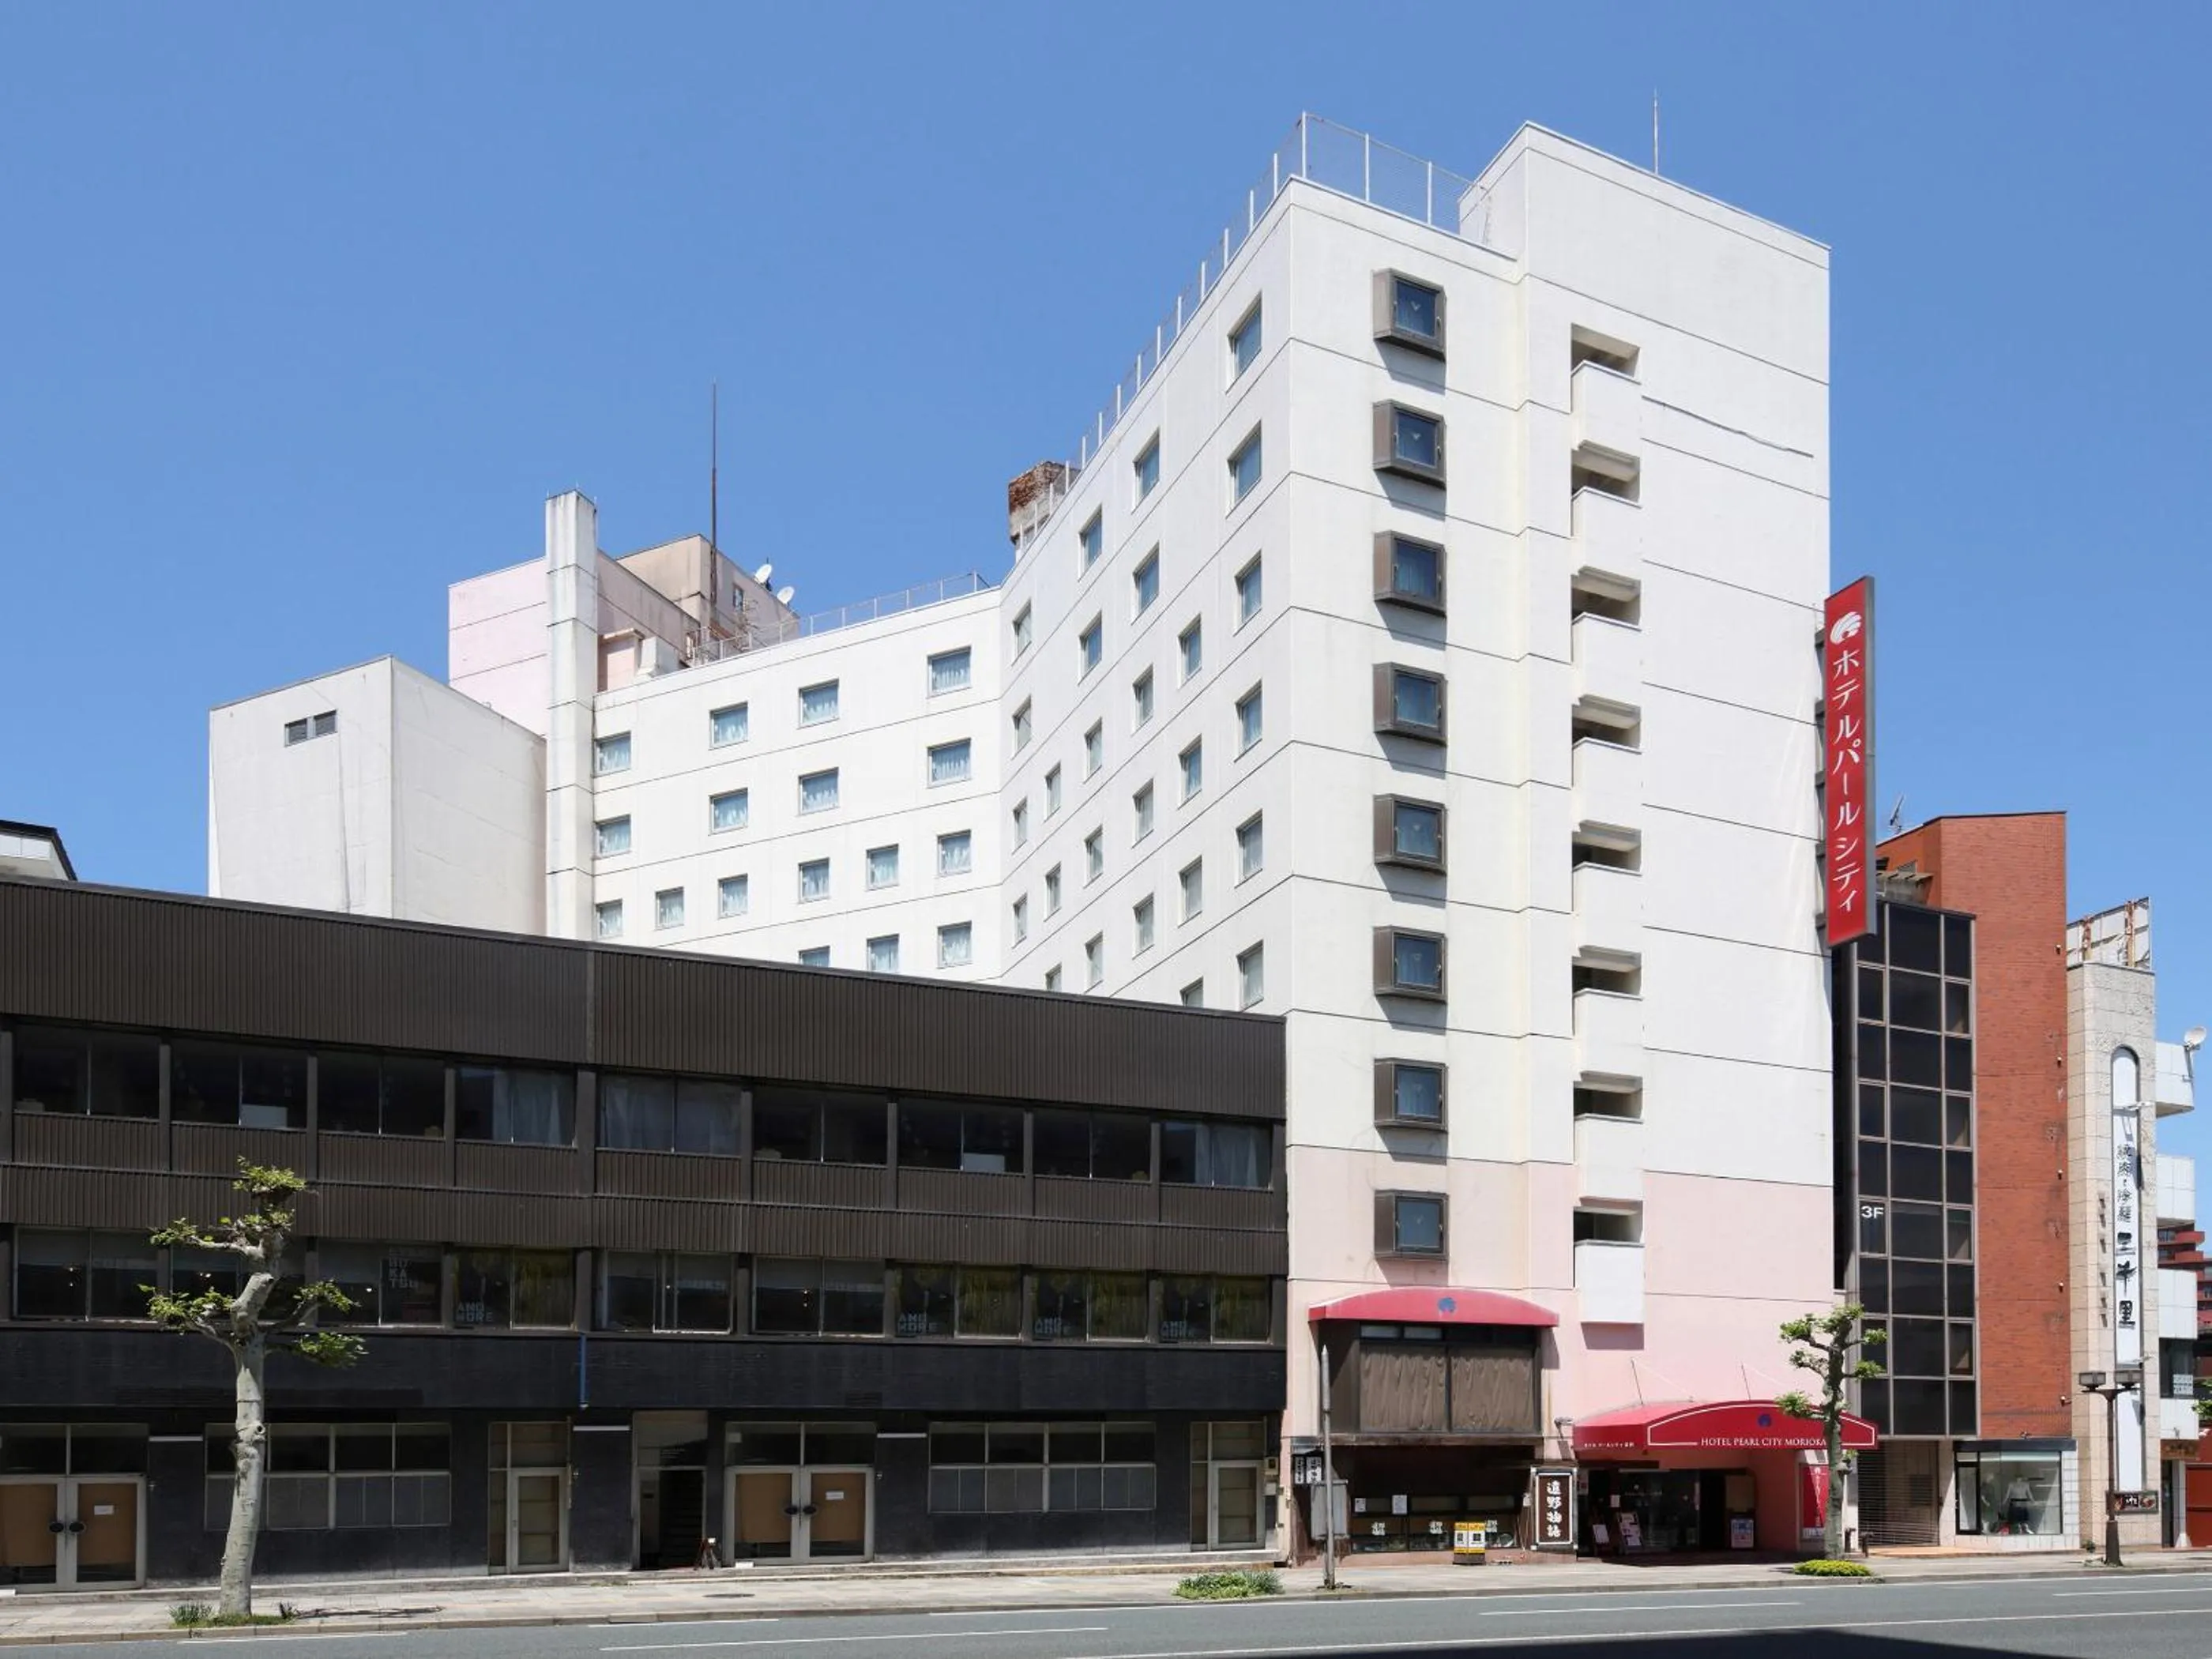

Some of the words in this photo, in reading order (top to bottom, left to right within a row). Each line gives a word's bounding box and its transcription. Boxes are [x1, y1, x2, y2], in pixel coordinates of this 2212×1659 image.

[1832, 650, 1861, 912] ホテルパールシティ
[1860, 1206, 1884, 1219] 3F
[1701, 1437, 1731, 1446] HOTEL
[1733, 1437, 1760, 1446] PEARL
[1762, 1437, 1781, 1446] CITY
